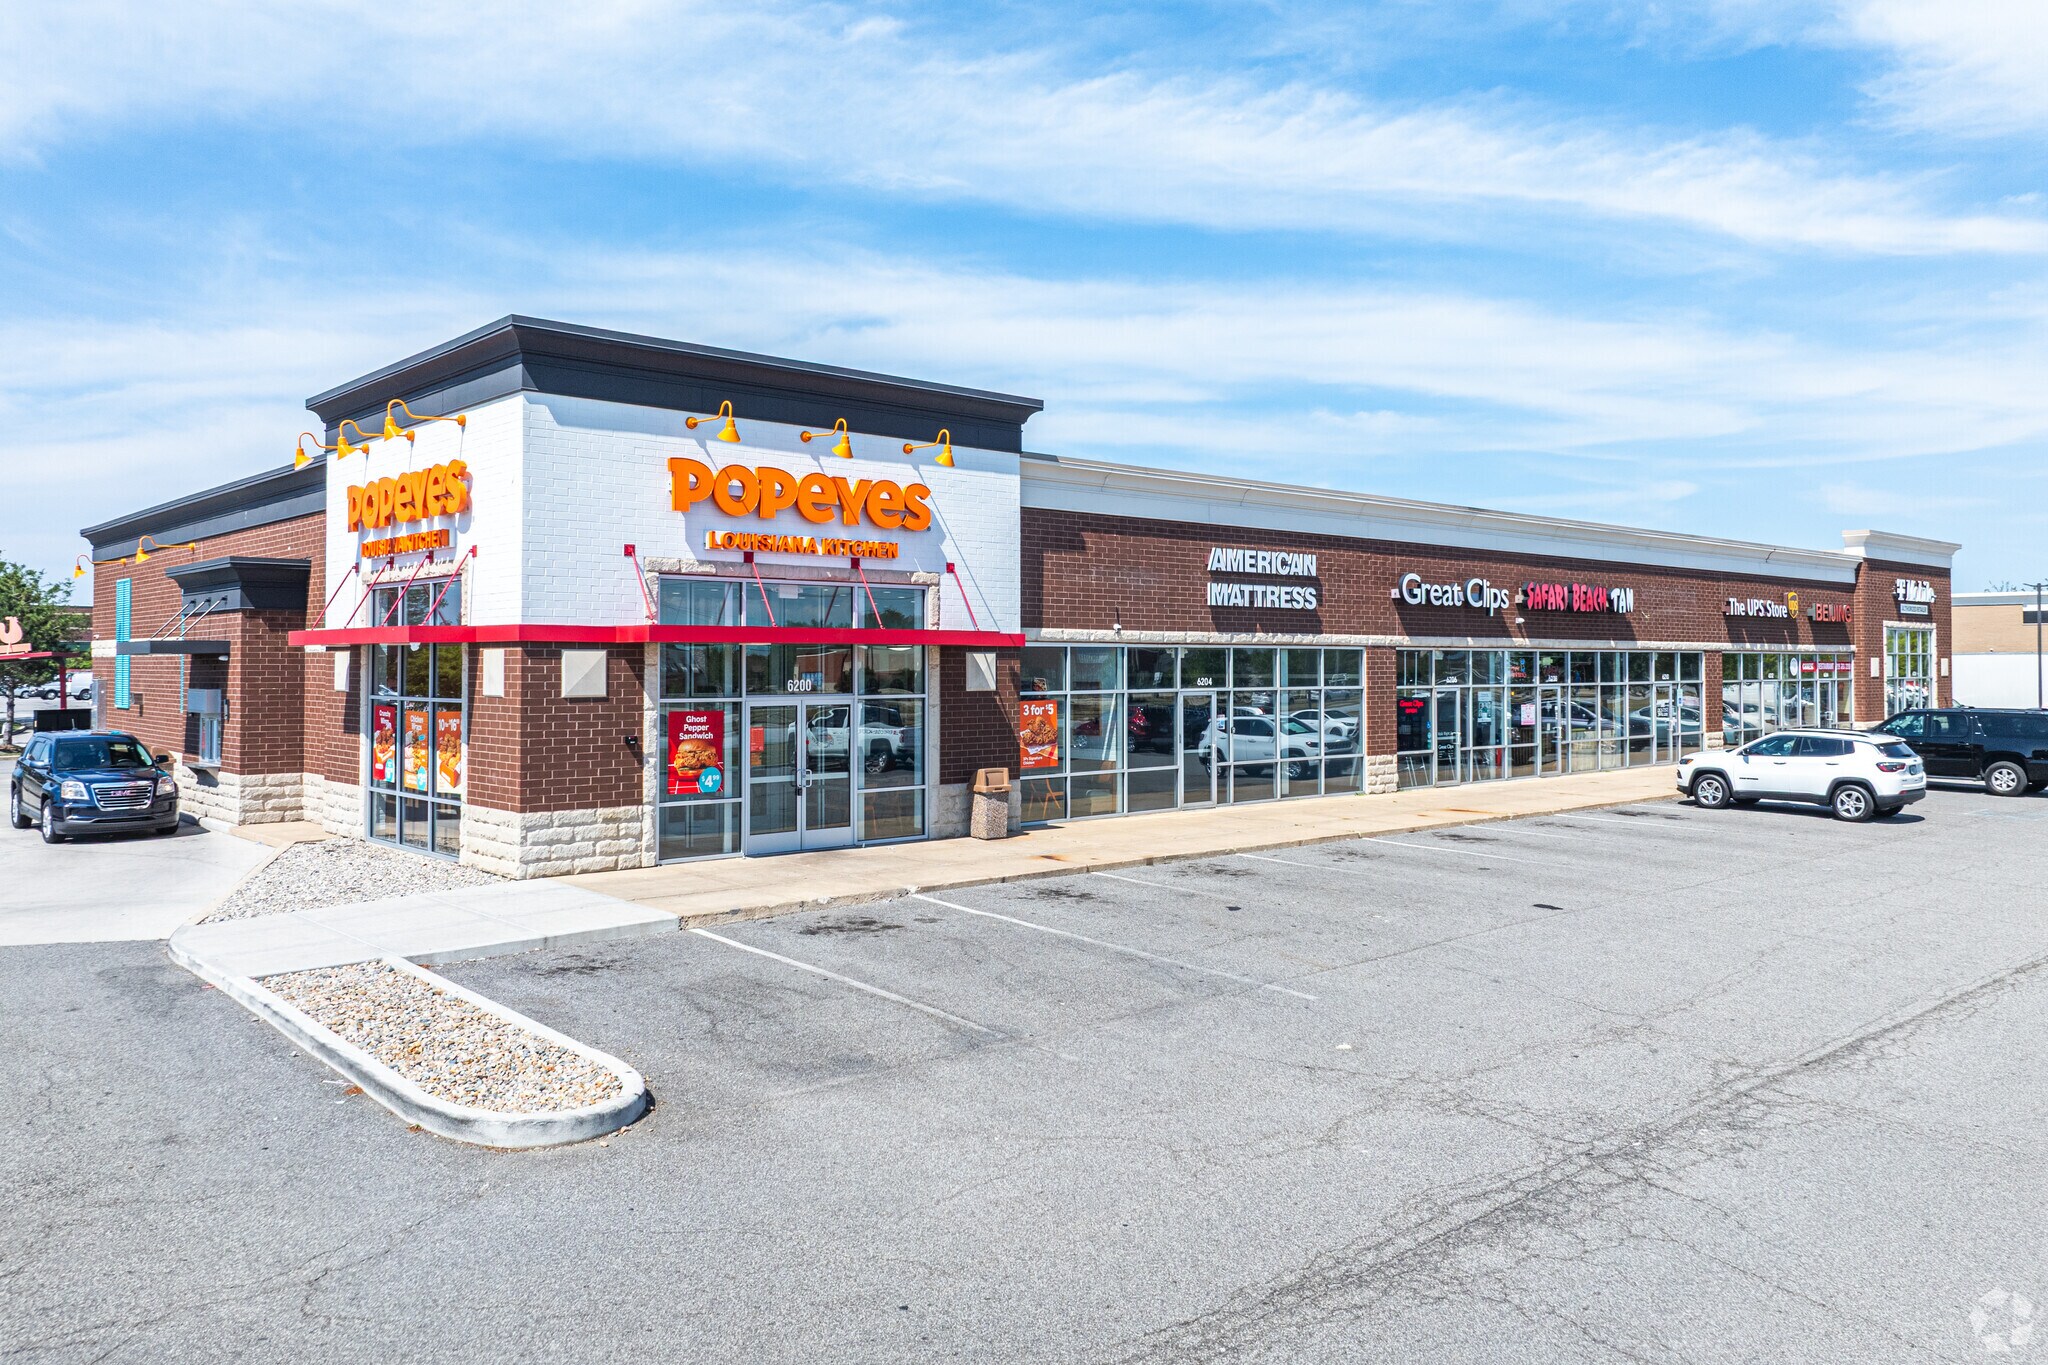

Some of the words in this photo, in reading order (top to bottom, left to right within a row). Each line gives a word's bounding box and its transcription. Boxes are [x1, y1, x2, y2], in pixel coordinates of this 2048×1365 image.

[706, 530, 819, 555] LOUISIANA
[821, 537, 899, 559] KITCHEN
[1207, 547, 1317, 577] AMERICAN
[1207, 582, 1317, 610] MATTRESS
[1399, 572, 1463, 607] Great
[1464, 577, 1510, 617] Clips
[1526, 581, 1569, 611] SAFARI
[1571, 582, 1607, 613] BEACH
[1610, 587, 1634, 614] TAN
[1728, 597, 1746, 616] The
[1747, 598, 1765, 618] UPS
[1766, 599, 1788, 618] Store
[1815, 603, 1852, 622] BEIJING
[787, 679, 812, 692] 6200
[1196, 677, 1213, 686] 6204
[685, 715, 707, 723] Ghost
[1023, 704, 1029, 716] 3
[1030, 704, 1045, 716] for
[679, 732, 714, 740] Sandwich
[683, 724, 710, 732] Pepper
